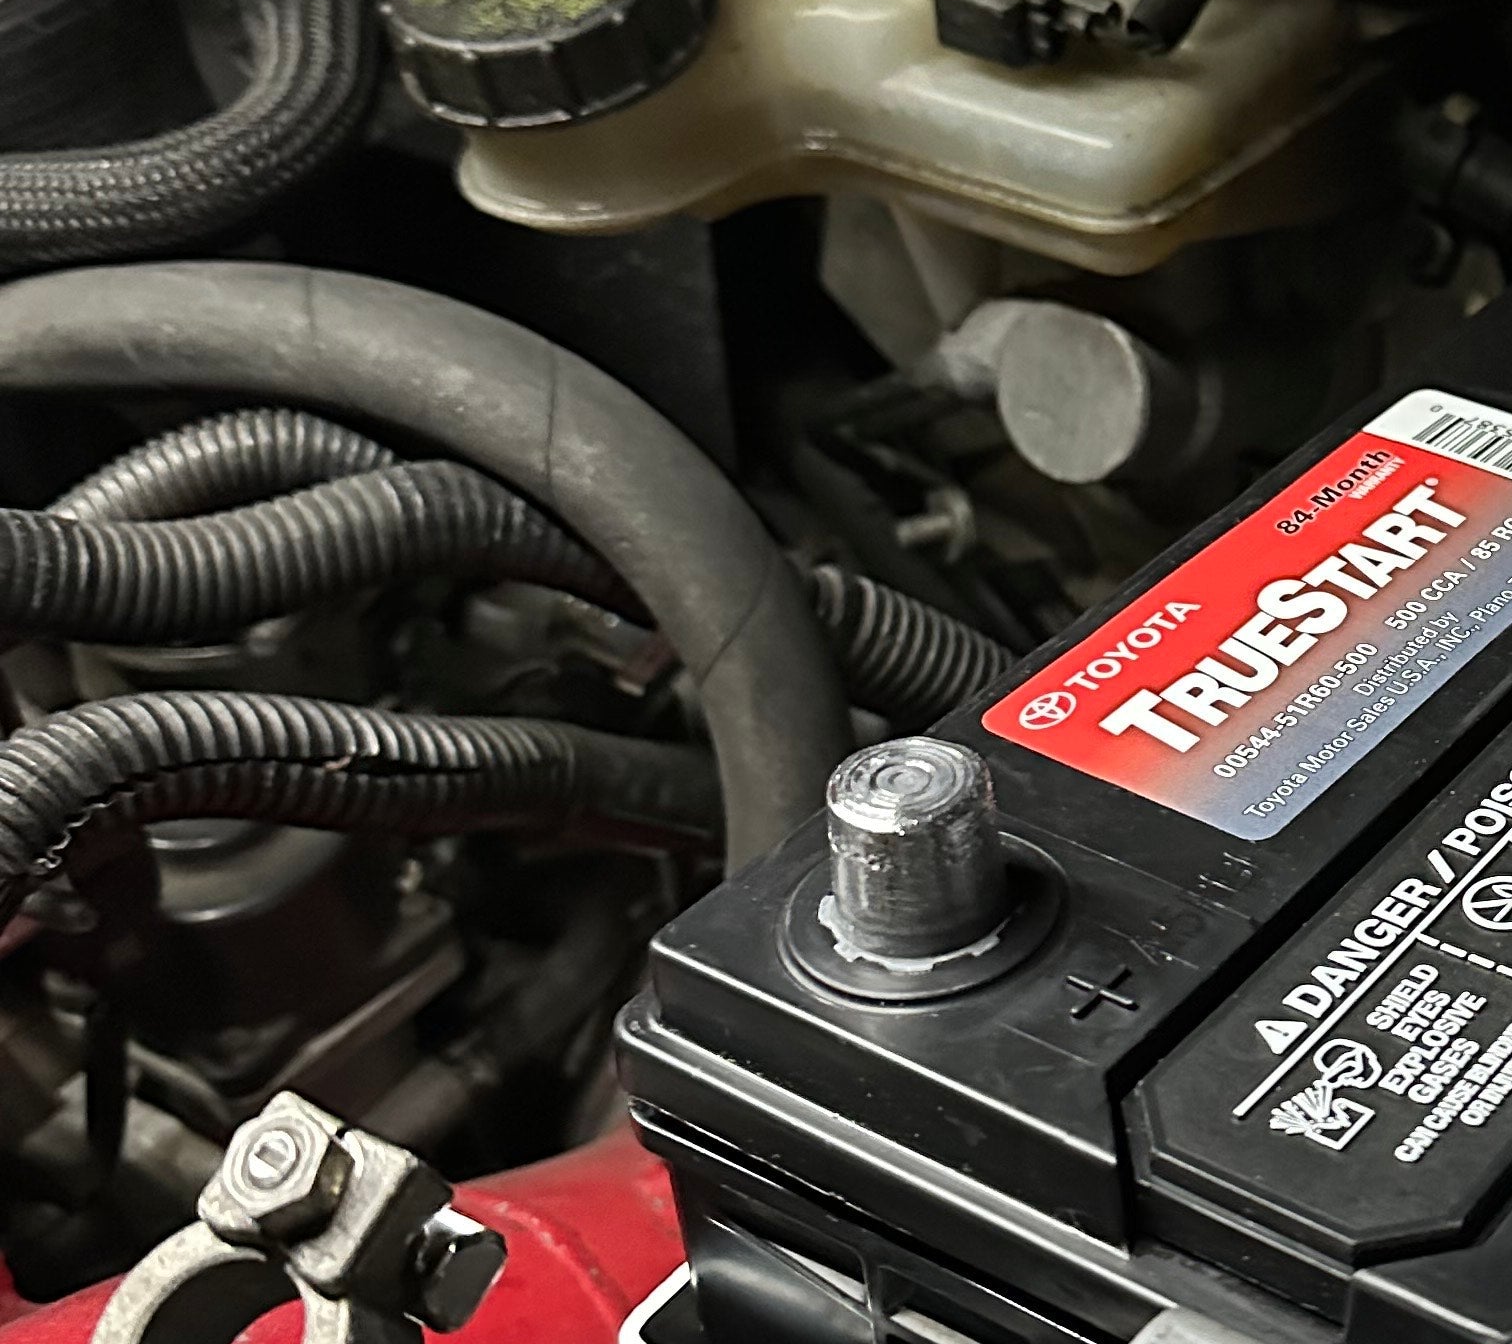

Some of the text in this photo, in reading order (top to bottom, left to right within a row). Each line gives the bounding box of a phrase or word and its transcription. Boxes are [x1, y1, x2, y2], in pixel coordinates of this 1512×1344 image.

[1429, 403, 1444, 414] 0
[1276, 450, 1392, 536] 84-Month
[1062, 600, 1203, 692] TOYOTA
[1212, 641, 1380, 779] 00544-51R60-500
[1383, 600, 1429, 631] 500
[1419, 569, 1469, 602] CCA
[1459, 556, 1477, 572] /
[1469, 538, 1502, 561] 85
[1351, 610, 1460, 698] Distributed by
[1242, 773, 1308, 817] Toyota
[1298, 727, 1354, 773] Motor
[1346, 696, 1396, 732] Sales
[1385, 654, 1447, 695] U.S.A.,
[1435, 619, 1480, 652] INC.,
[1281, 878, 1443, 1019] DANGER
[1427, 849, 1456, 884] /
[1365, 964, 1439, 1030] SHIELD
[1390, 989, 1452, 1042] EYES
[1377, 991, 1487, 1095] EXPLOSIVE
[1407, 1037, 1480, 1104] GASES
[1394, 1125, 1440, 1162] CAN
[1422, 1079, 1481, 1131] CAUSE
[1459, 1092, 1501, 1126] OR
